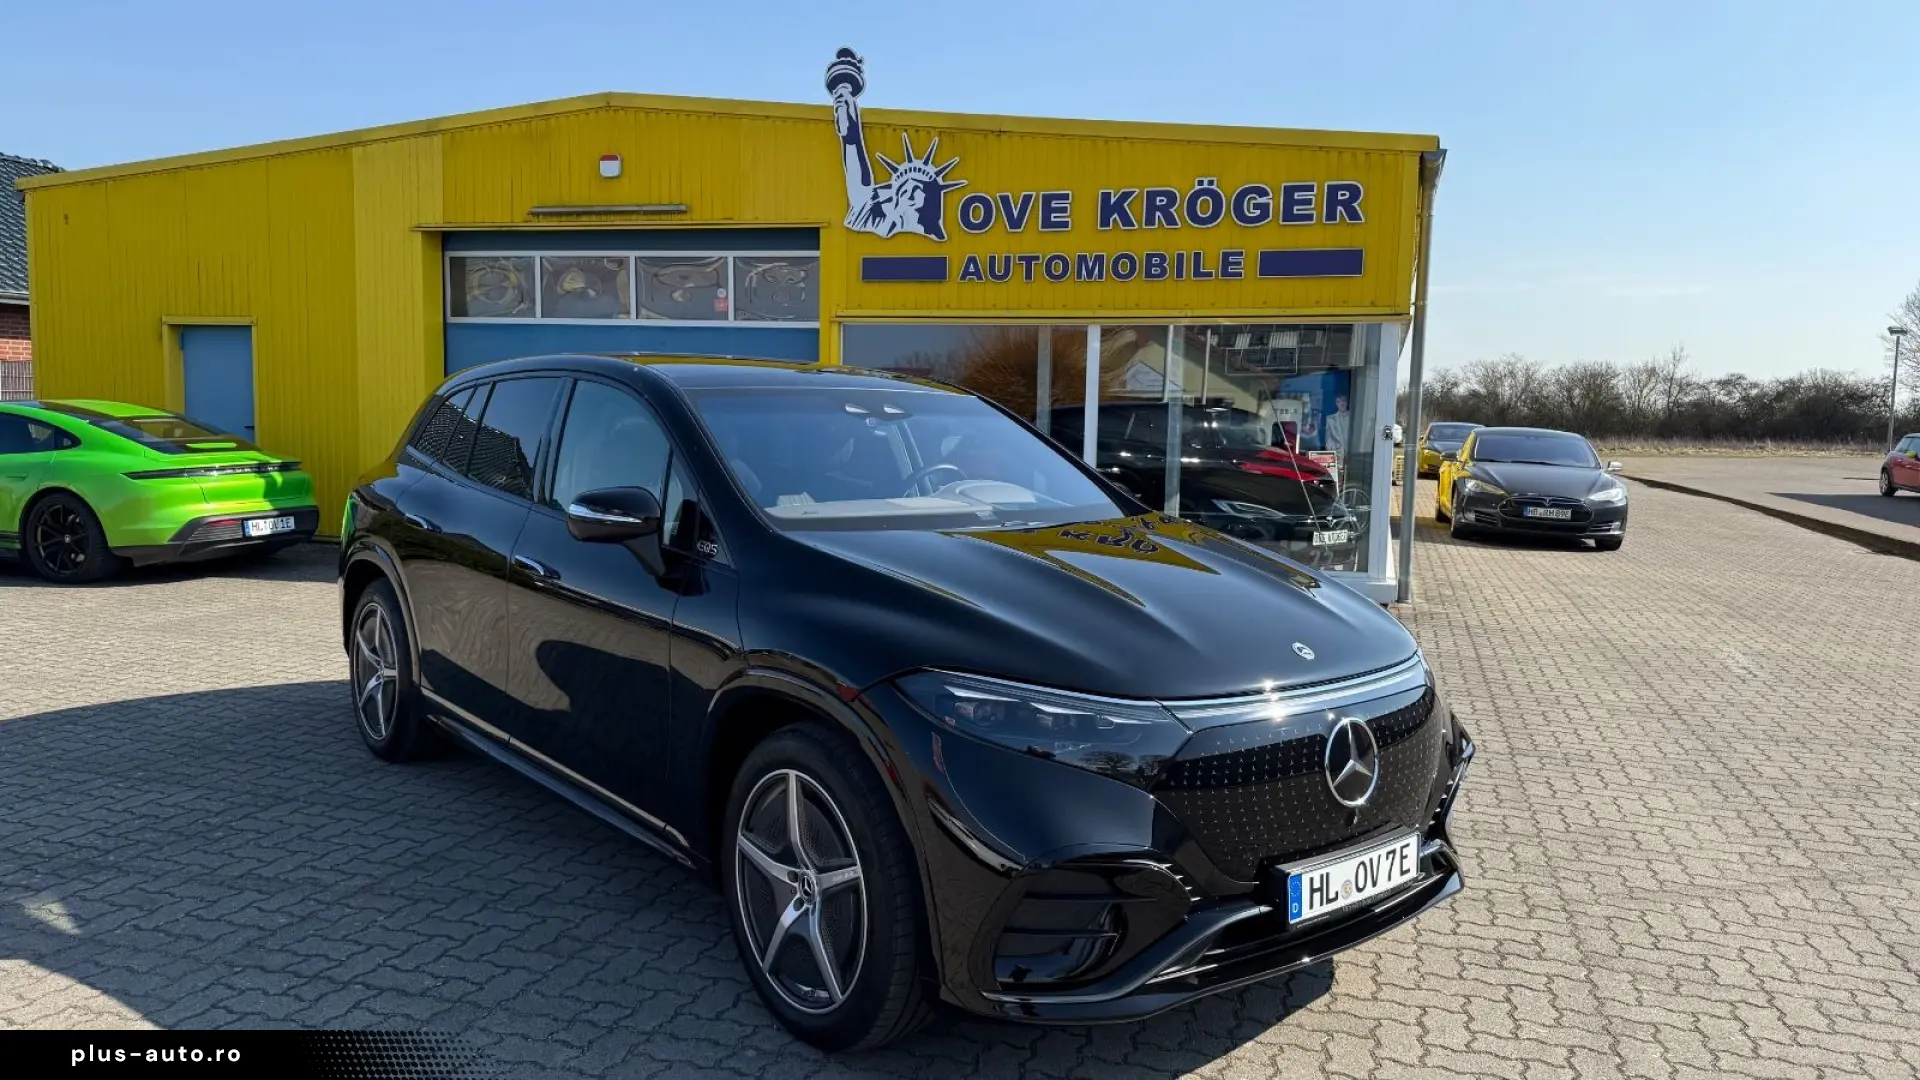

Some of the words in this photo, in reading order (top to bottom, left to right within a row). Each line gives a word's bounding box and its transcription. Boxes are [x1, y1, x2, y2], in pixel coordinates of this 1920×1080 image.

[958, 190, 1073, 233] OVE
[1097, 177, 1366, 230] KRÖGER
[957, 249, 1245, 283] AUTOMOBILE
[1308, 871, 1339, 910] HL
[1354, 853, 1382, 893] OV
[1385, 843, 1411, 882] 7E
[1292, 902, 1299, 914] D
